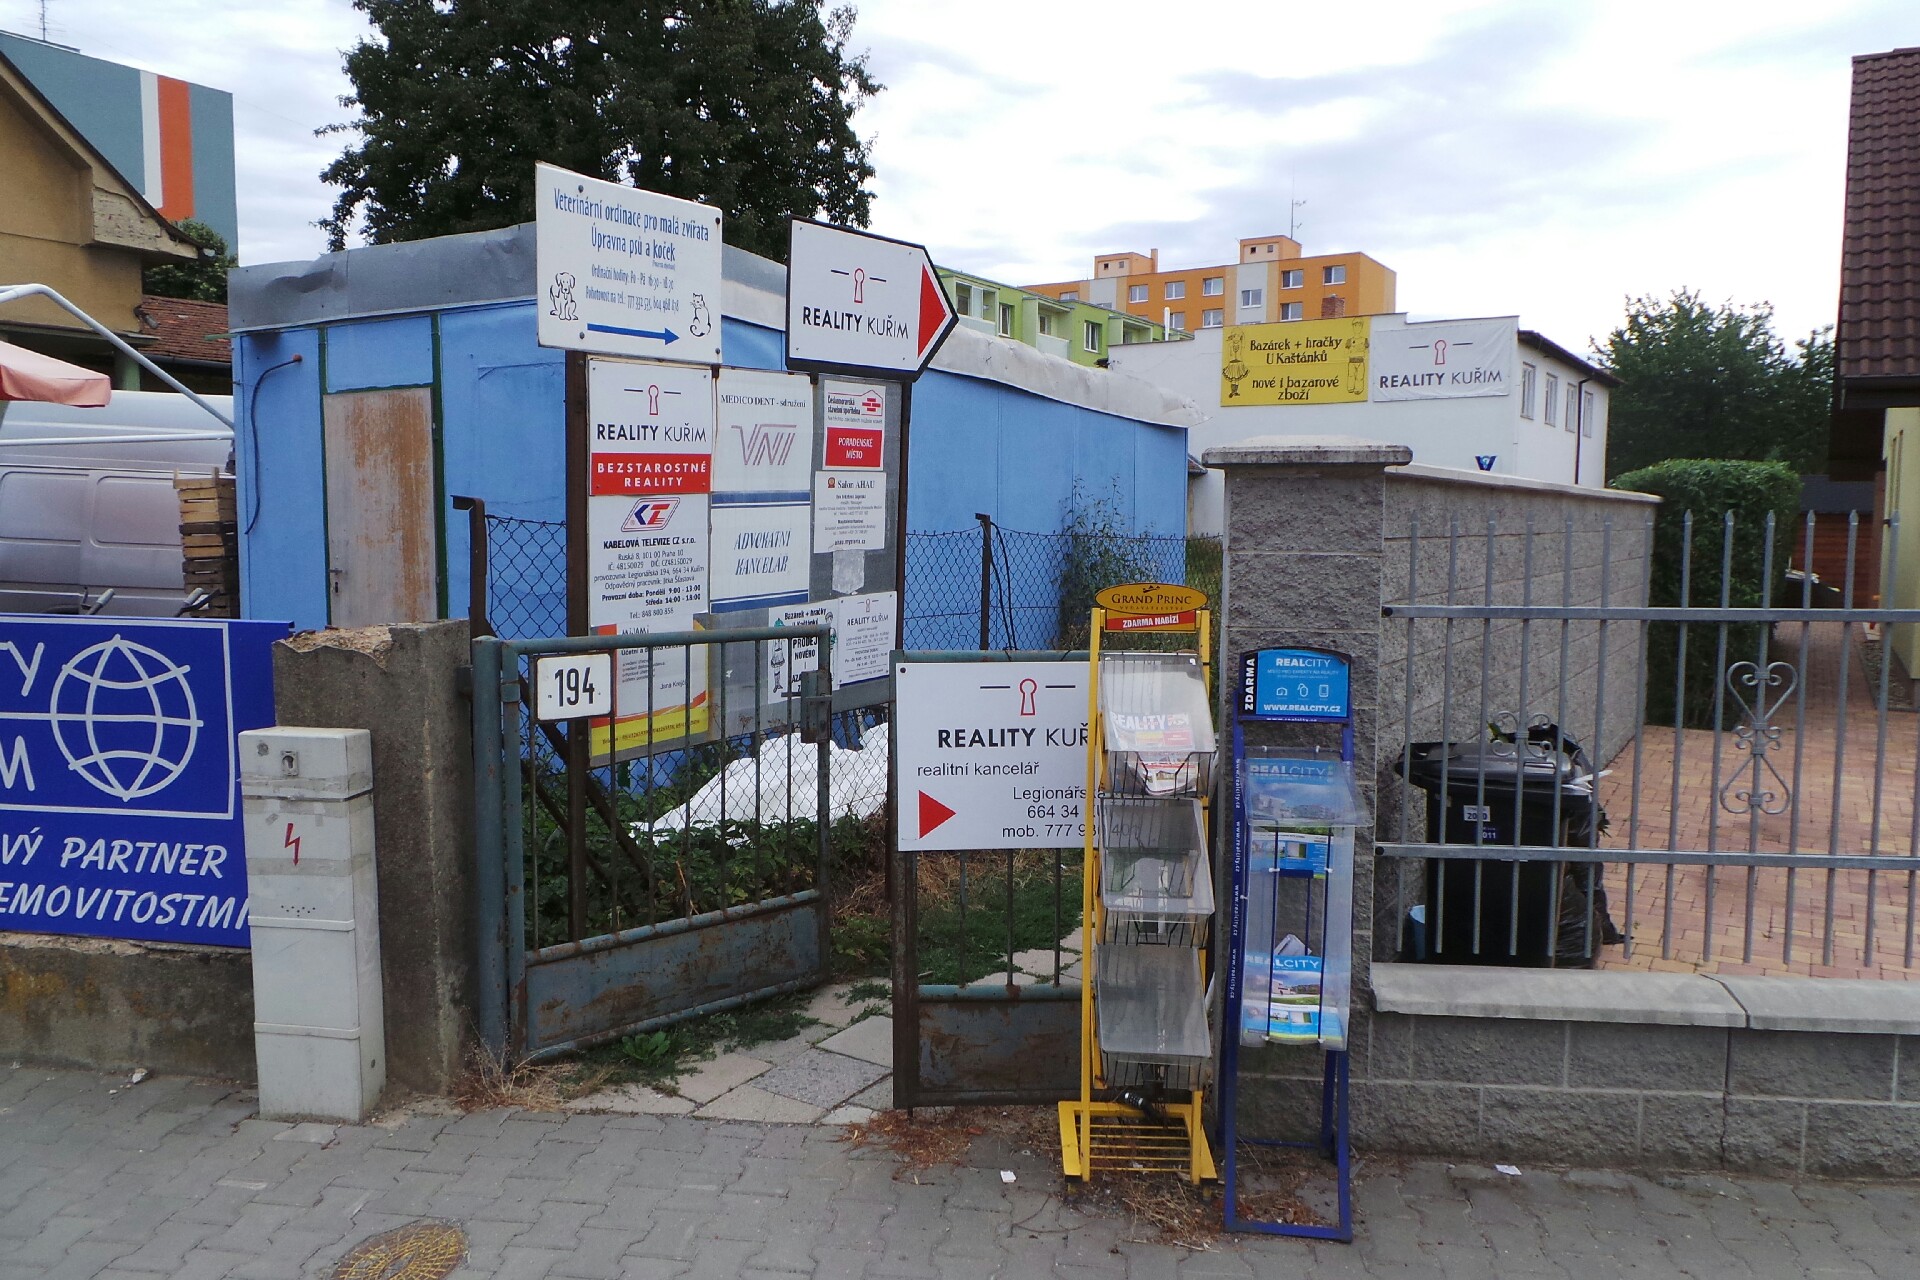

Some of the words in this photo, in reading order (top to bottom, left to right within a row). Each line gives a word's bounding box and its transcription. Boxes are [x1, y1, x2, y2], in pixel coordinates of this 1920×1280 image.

[554, 188, 602, 219] Veterinární
[605, 204, 641, 228] ordinace
[644, 214, 658, 231] pro
[660, 215, 679, 235] malá
[682, 220, 709, 242] zvířata
[591, 222, 626, 252] Úpravna
[630, 235, 642, 258] psů
[645, 242, 650, 256] a
[653, 240, 676, 262] koček
[803, 306, 862, 332] REALITY
[867, 314, 908, 339] KUŘIM
[1250, 338, 1290, 351] Bazárek
[1295, 341, 1302, 349] +
[1306, 337, 1342, 350] hračky
[1266, 354, 1274, 364] U
[1276, 350, 1327, 364] Kaštánků
[1252, 377, 1276, 388] nové
[1286, 375, 1339, 388] bazarové
[1379, 372, 1445, 388] REALITY
[1451, 367, 1502, 385] KUŘIM
[1278, 387, 1310, 401] zboží
[721, 395, 753, 405] MEDICO
[754, 397, 775, 406] DENT
[780, 399, 806, 408] sdružení
[597, 424, 658, 440] REALITY
[664, 422, 706, 442] KUŘIM
[838, 437, 873, 448] PORADENSKÉ
[846, 449, 863, 459] MÍSTO
[597, 461, 706, 473] BEZSTAROSTNÉ
[624, 477, 682, 487] REALITY
[604, 537, 639, 549] KABELOVÁ
[642, 537, 670, 547] TELEVIZE
[734, 528, 791, 550] ADVOKÁTNÍ
[646, 597, 662, 606] Středa
[1112, 594, 1152, 604] GRAND
[1158, 594, 1192, 604] PRINC
[847, 616, 870, 626] REALITY
[1123, 618, 1153, 628] ZDARMA
[1155, 614, 1179, 625] NABÍZÍ
[793, 637, 817, 649] PRODEJ
[795, 649, 815, 660] NOVÉHO
[1276, 658, 1330, 667] REALCITY
[555, 667, 594, 707] 194
[1245, 658, 1255, 710] ZDARMA
[1110, 711, 1165, 730] REALITY
[938, 728, 1036, 748] REALITY
[1046, 722, 1089, 746] KUŘ
[917, 762, 969, 777] realitní
[974, 762, 1040, 775] kancelář
[1027, 805, 1055, 819] 664
[1060, 805, 1079, 819] 34
[1002, 824, 1039, 838] mob.
[1045, 824, 1072, 837] 777
[60, 837, 228, 879] PARTNER
